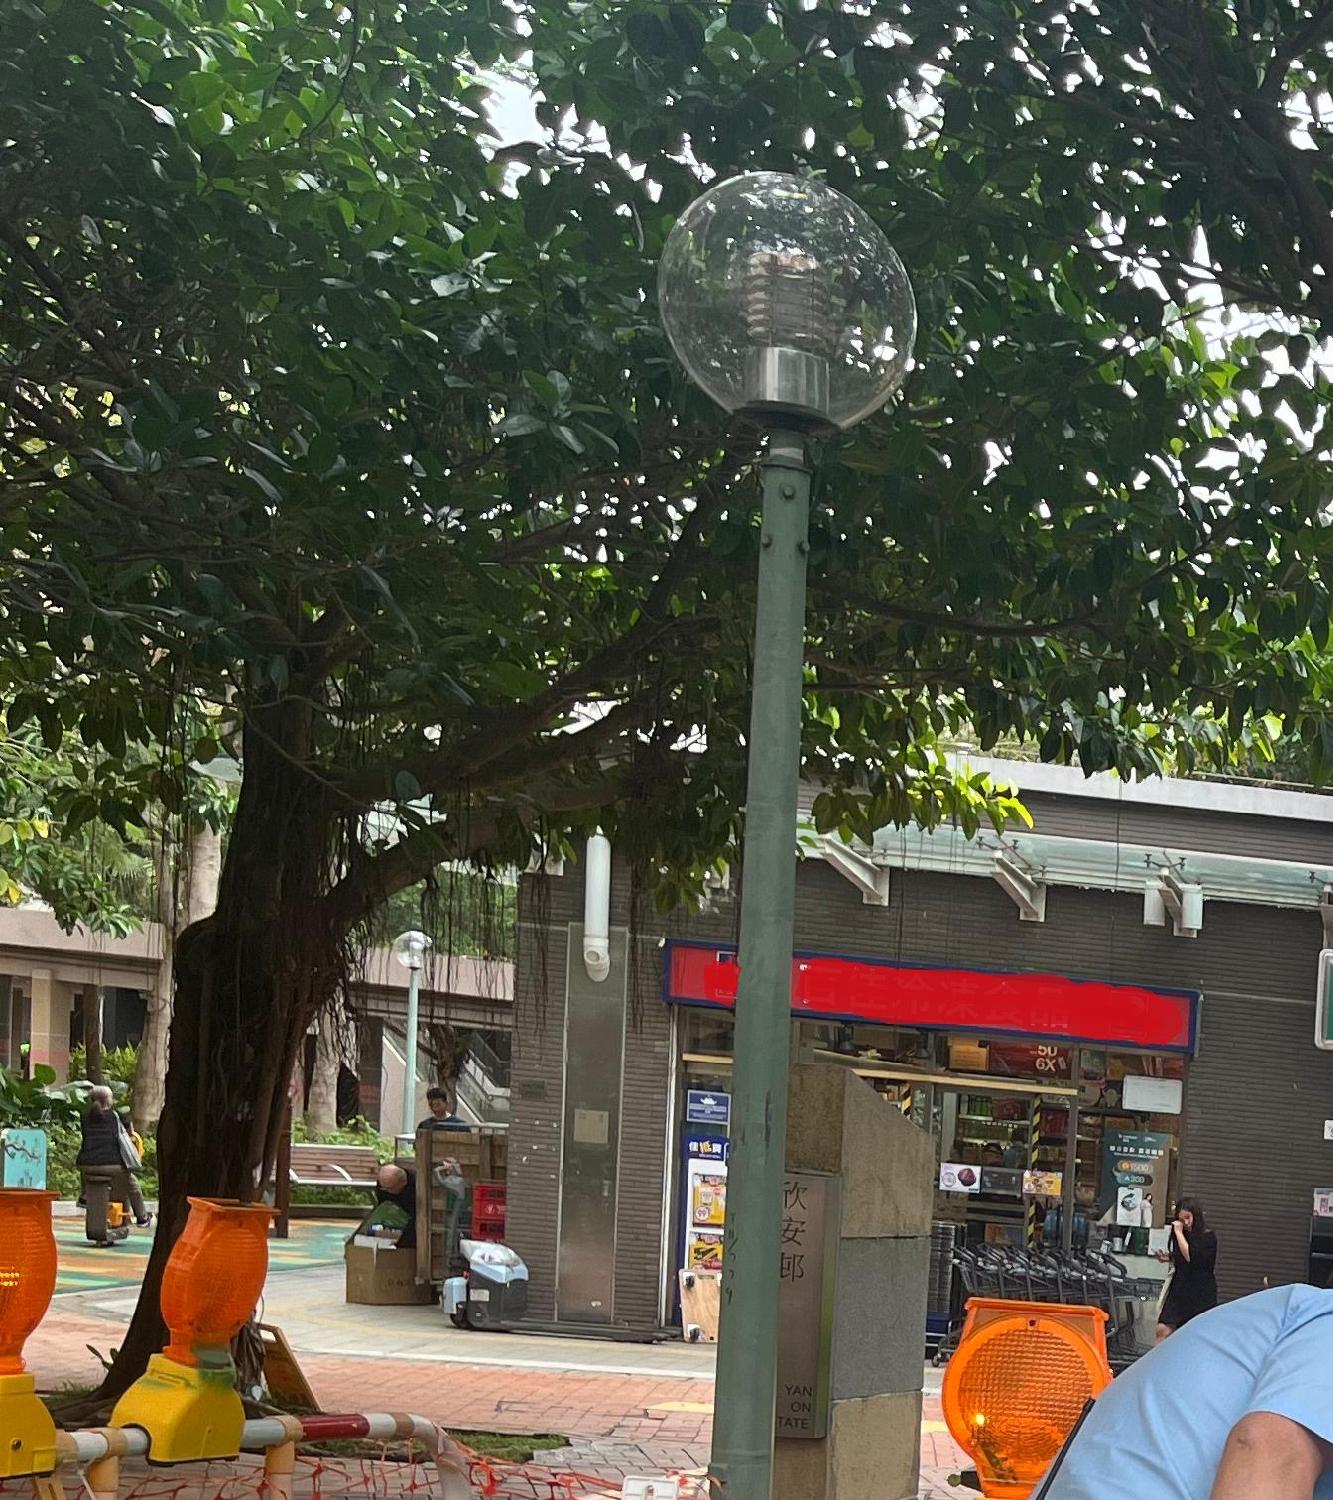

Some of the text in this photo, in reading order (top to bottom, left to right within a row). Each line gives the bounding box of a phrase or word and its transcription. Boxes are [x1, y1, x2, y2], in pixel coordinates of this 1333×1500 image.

[784, 1384, 813, 1396] YAN
[791, 1401, 811, 1412] ON
[777, 1416, 809, 1429] TATE
